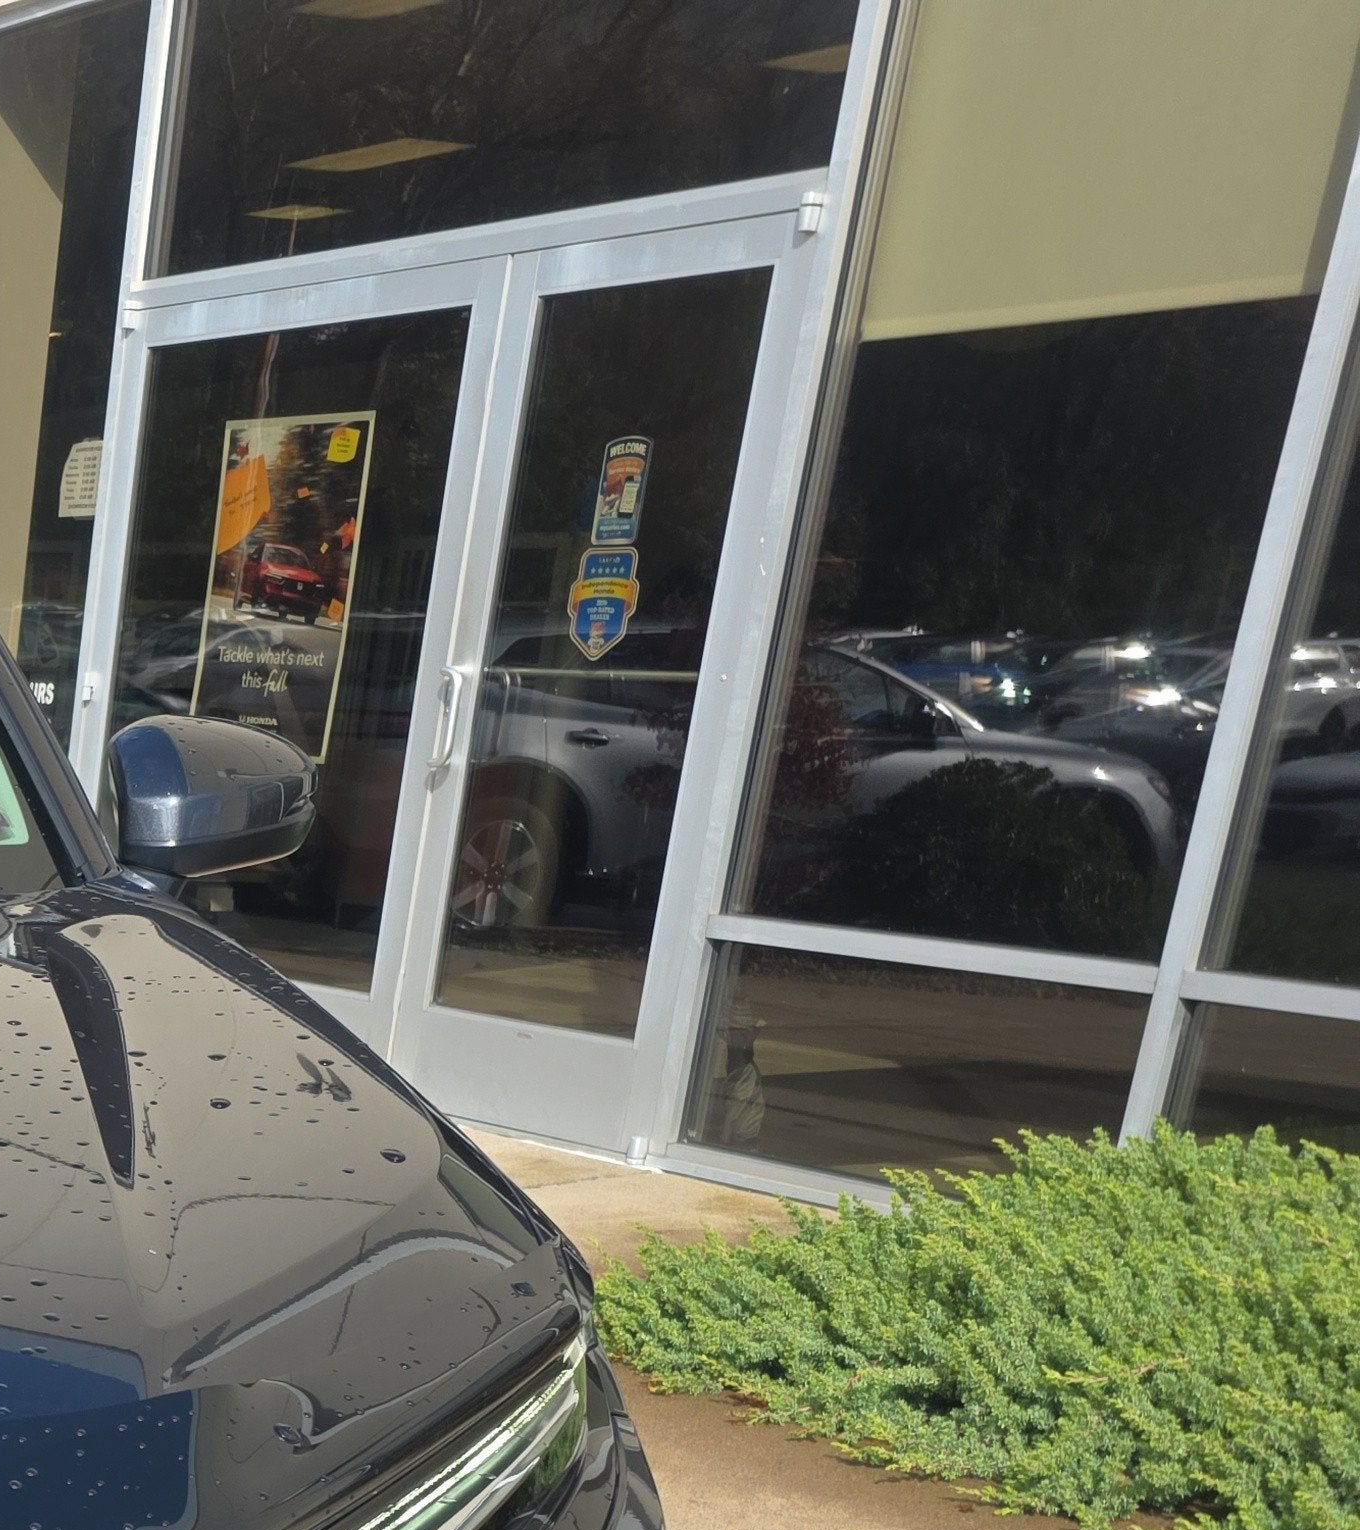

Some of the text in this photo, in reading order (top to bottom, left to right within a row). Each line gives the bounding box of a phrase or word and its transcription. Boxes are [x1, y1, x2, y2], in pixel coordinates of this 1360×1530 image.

[609, 442, 647, 457] WELCOME
[581, 581, 629, 590] Independence
[218, 646, 325, 666] Tackle what's next
[241, 671, 262, 688] this
[247, 716, 278, 726] HONDA
